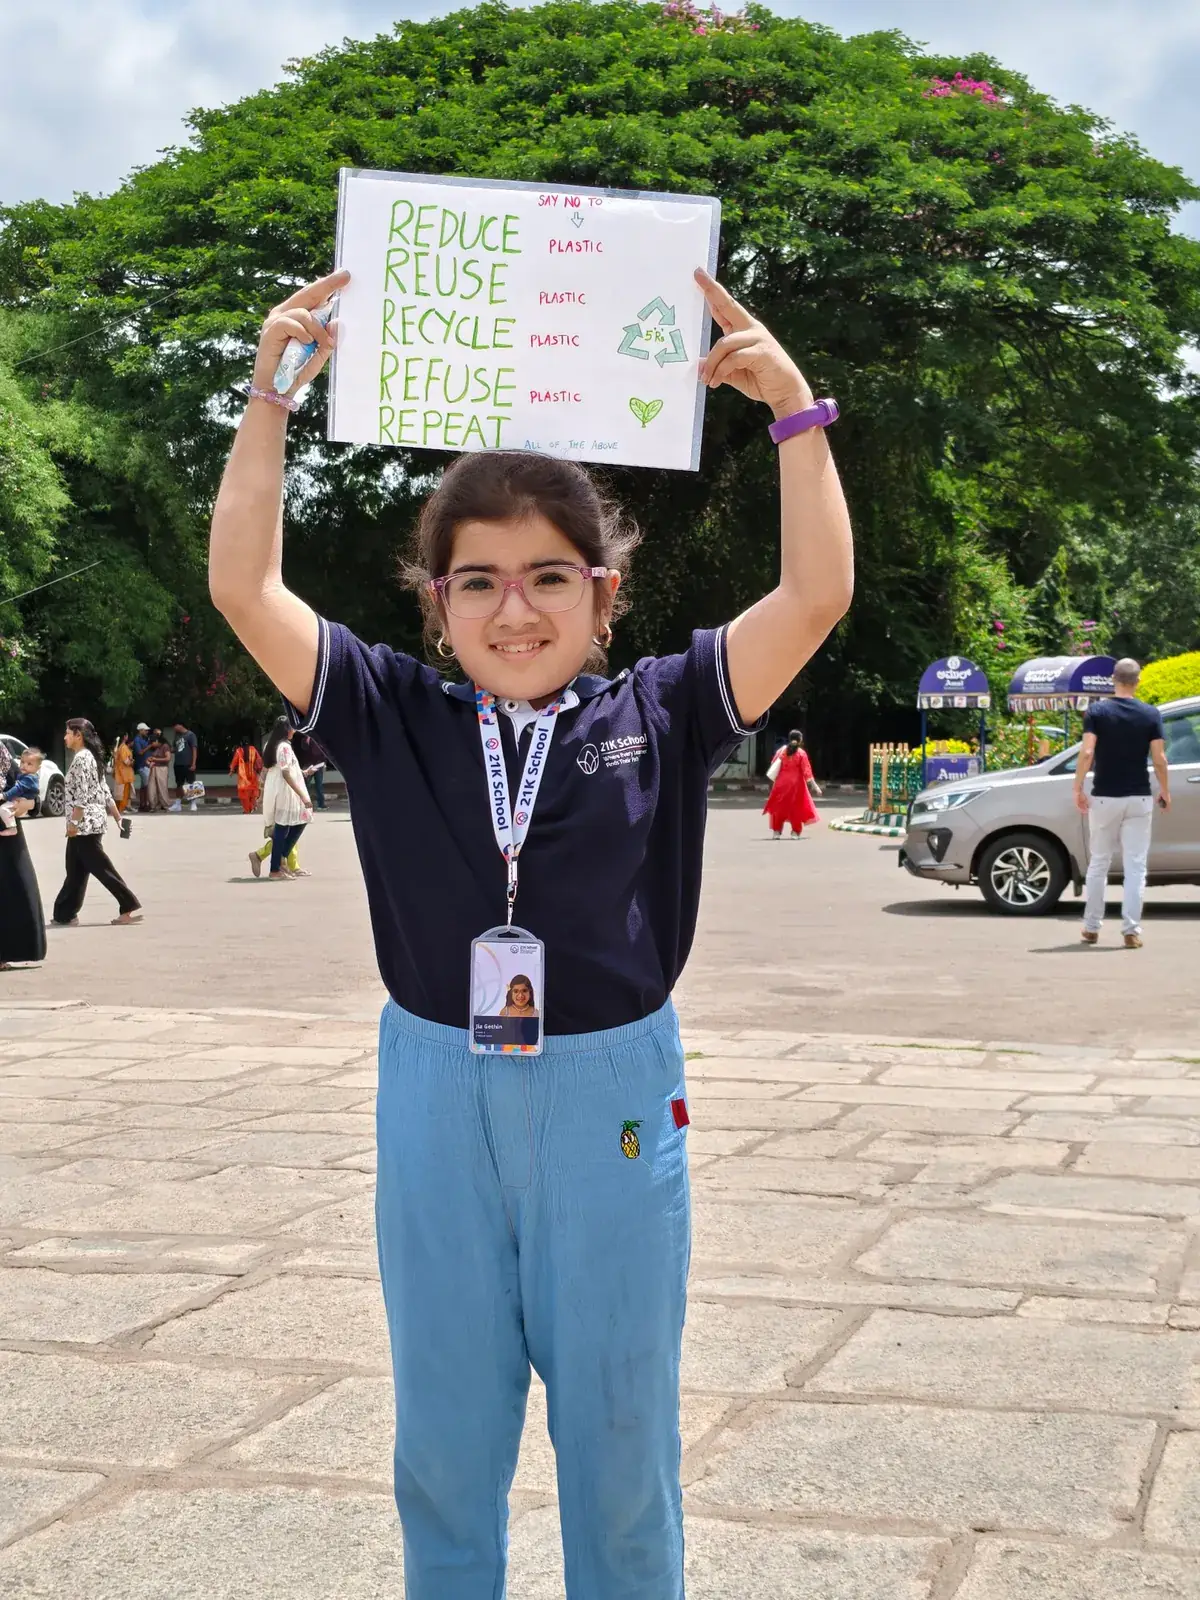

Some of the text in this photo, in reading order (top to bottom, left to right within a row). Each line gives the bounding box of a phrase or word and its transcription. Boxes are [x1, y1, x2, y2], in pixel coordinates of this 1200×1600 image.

[388, 199, 603, 254] REDUCE PLASTIC
[538, 194, 603, 208] SAY NO TO
[384, 248, 586, 305] REUSE PLASTIC
[381, 298, 580, 350] RECYCLE PLASTIC
[379, 350, 582, 408] REFUSE PLASTIC
[378, 405, 618, 450] REPEAT ALL OF THE ABOVE
[520, 727, 549, 806] 21K School
[600, 733, 648, 752] 21K School
[489, 754, 509, 831] 21K School
